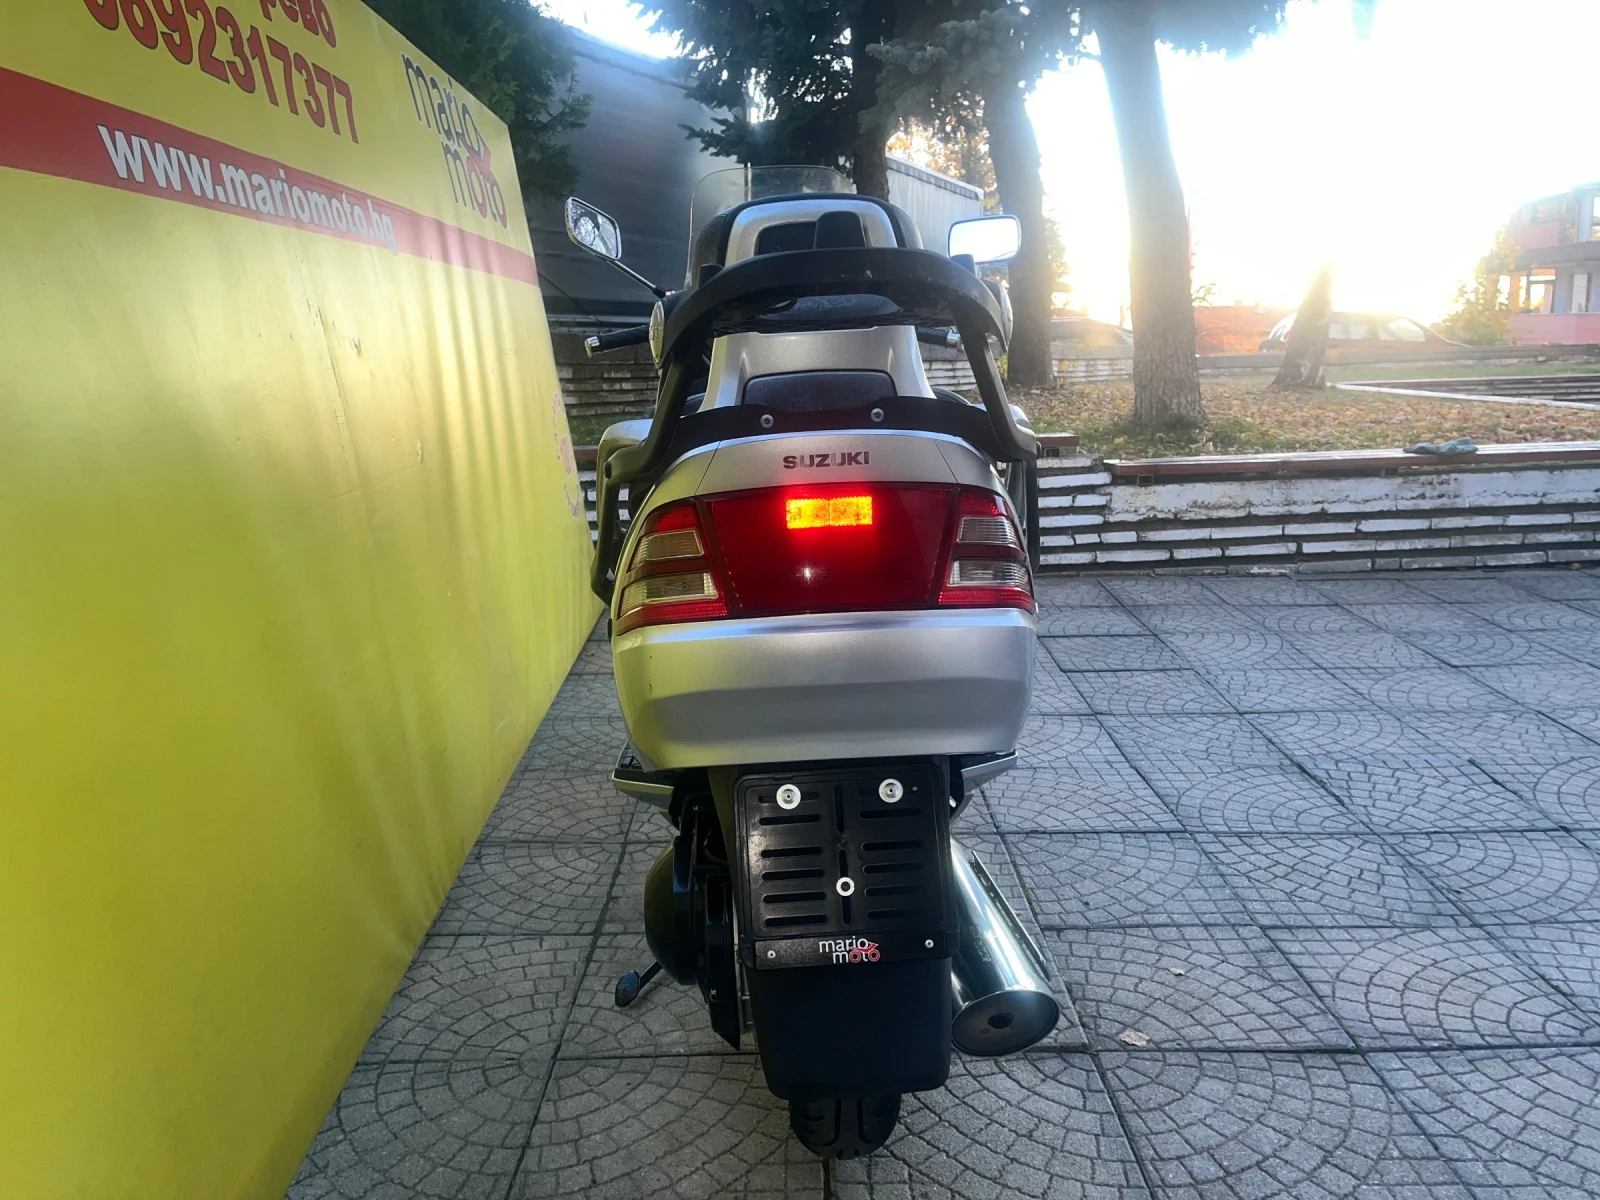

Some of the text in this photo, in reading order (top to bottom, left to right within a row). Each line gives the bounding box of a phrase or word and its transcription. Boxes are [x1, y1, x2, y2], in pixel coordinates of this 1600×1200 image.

[402, 53, 481, 153] mario
[97, 124, 399, 256] www.mariomoto.bg
[441, 141, 508, 230] moto
[782, 451, 871, 470] SUZUKI
[819, 935, 869, 953] mario
[832, 948, 881, 964] moto
